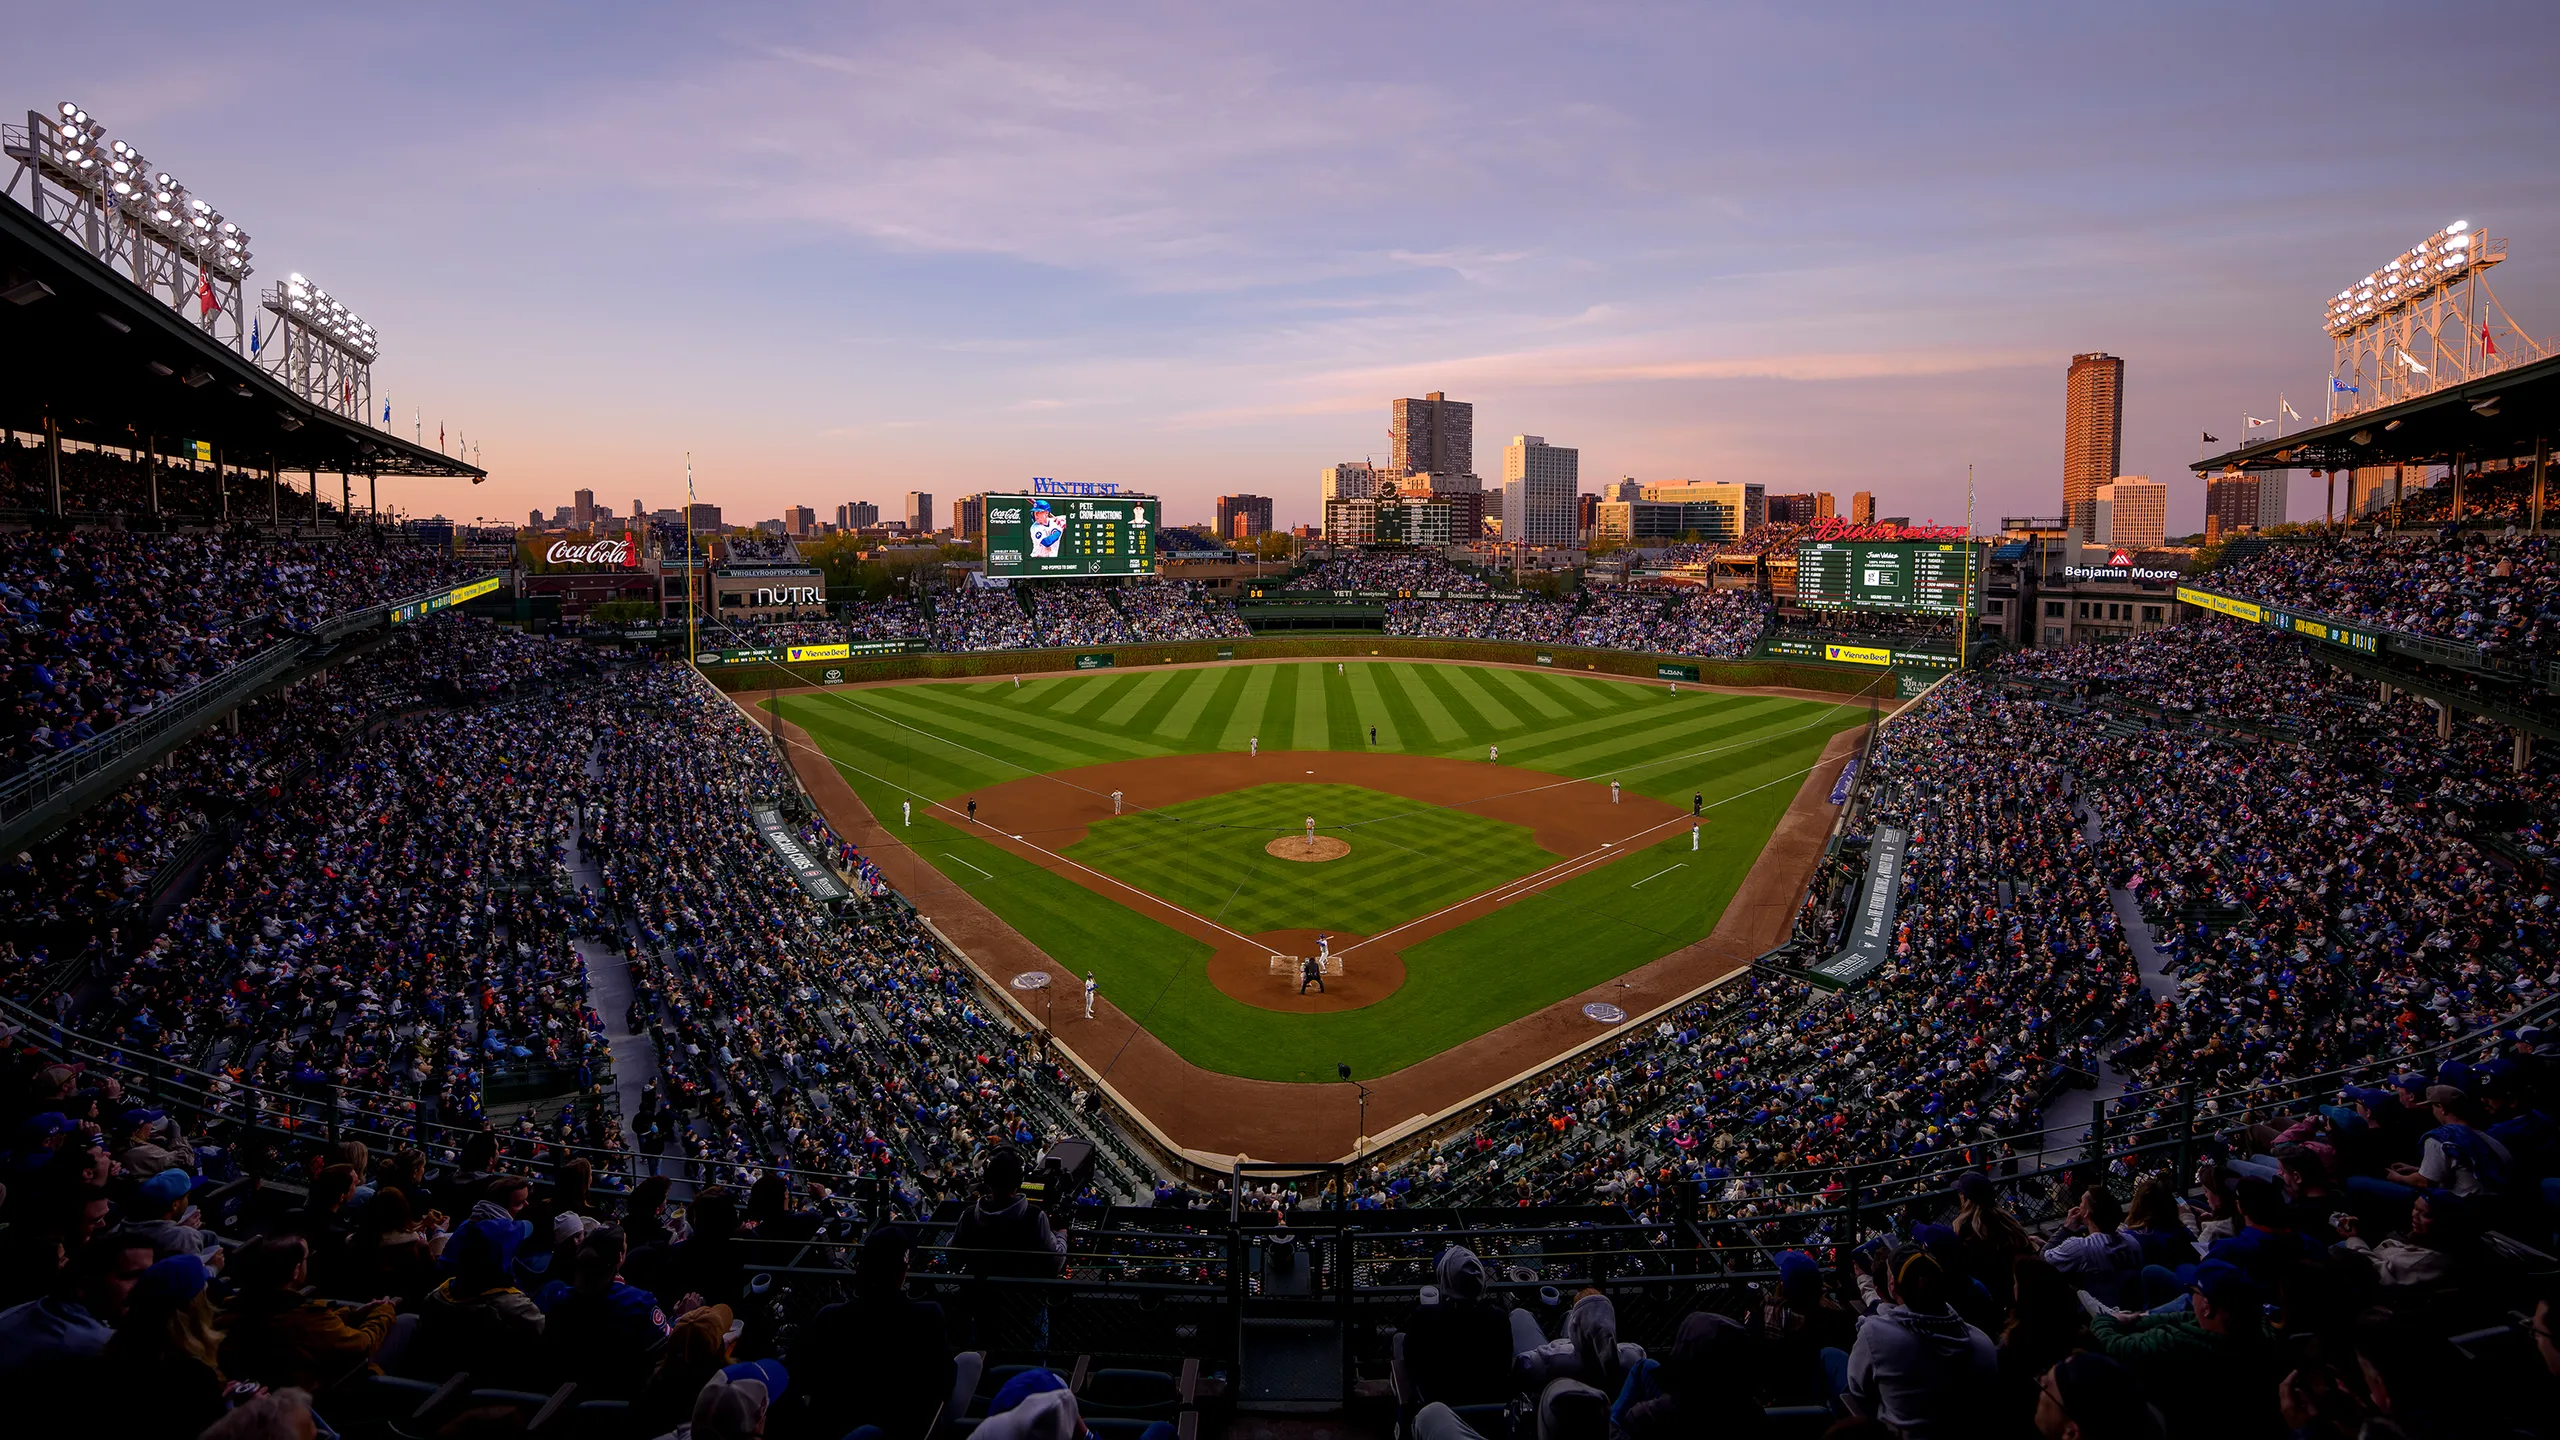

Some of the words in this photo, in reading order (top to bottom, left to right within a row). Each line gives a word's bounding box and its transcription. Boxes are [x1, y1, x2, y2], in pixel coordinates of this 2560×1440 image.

[1033, 478, 1119, 496] WINTRUST
[990, 508, 1022, 520] Coca-Cola
[1080, 511, 1122, 520] CROW-ARMSTRONG
[1810, 516, 1970, 540] Budweiser
[546, 540, 630, 564] Coca-Cola
[2064, 566, 2126, 579] Benjamin
[2131, 568, 2178, 579] Moore
[2295, 618, 2327, 639] CROW-ARMSTRONG
[832, 649, 847, 658] Beef
[1844, 650, 1869, 660] Vienna
[1870, 652, 1888, 663] Beef
[769, 832, 800, 854] CHICAGO
[788, 853, 814, 871] CUBS
[817, 877, 839, 895] WINTRUST
[1821, 952, 1864, 975] WINTRUST
